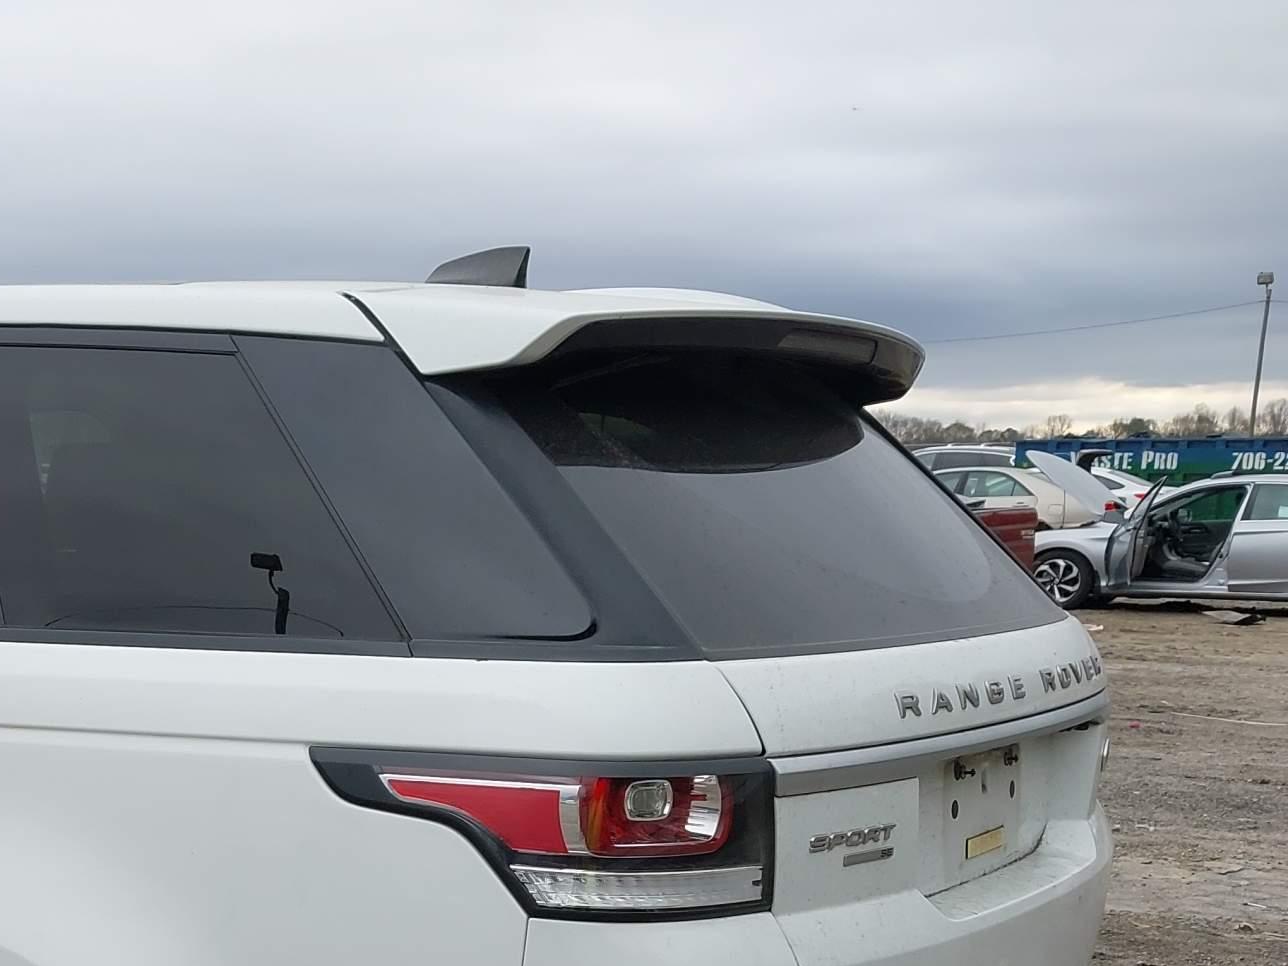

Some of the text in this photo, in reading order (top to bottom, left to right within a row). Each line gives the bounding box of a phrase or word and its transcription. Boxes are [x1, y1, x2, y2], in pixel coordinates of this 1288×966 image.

[1141, 451, 1178, 470] PRO
[894, 655, 1101, 719] RANGE ROVER
[808, 823, 897, 854] SPORT
